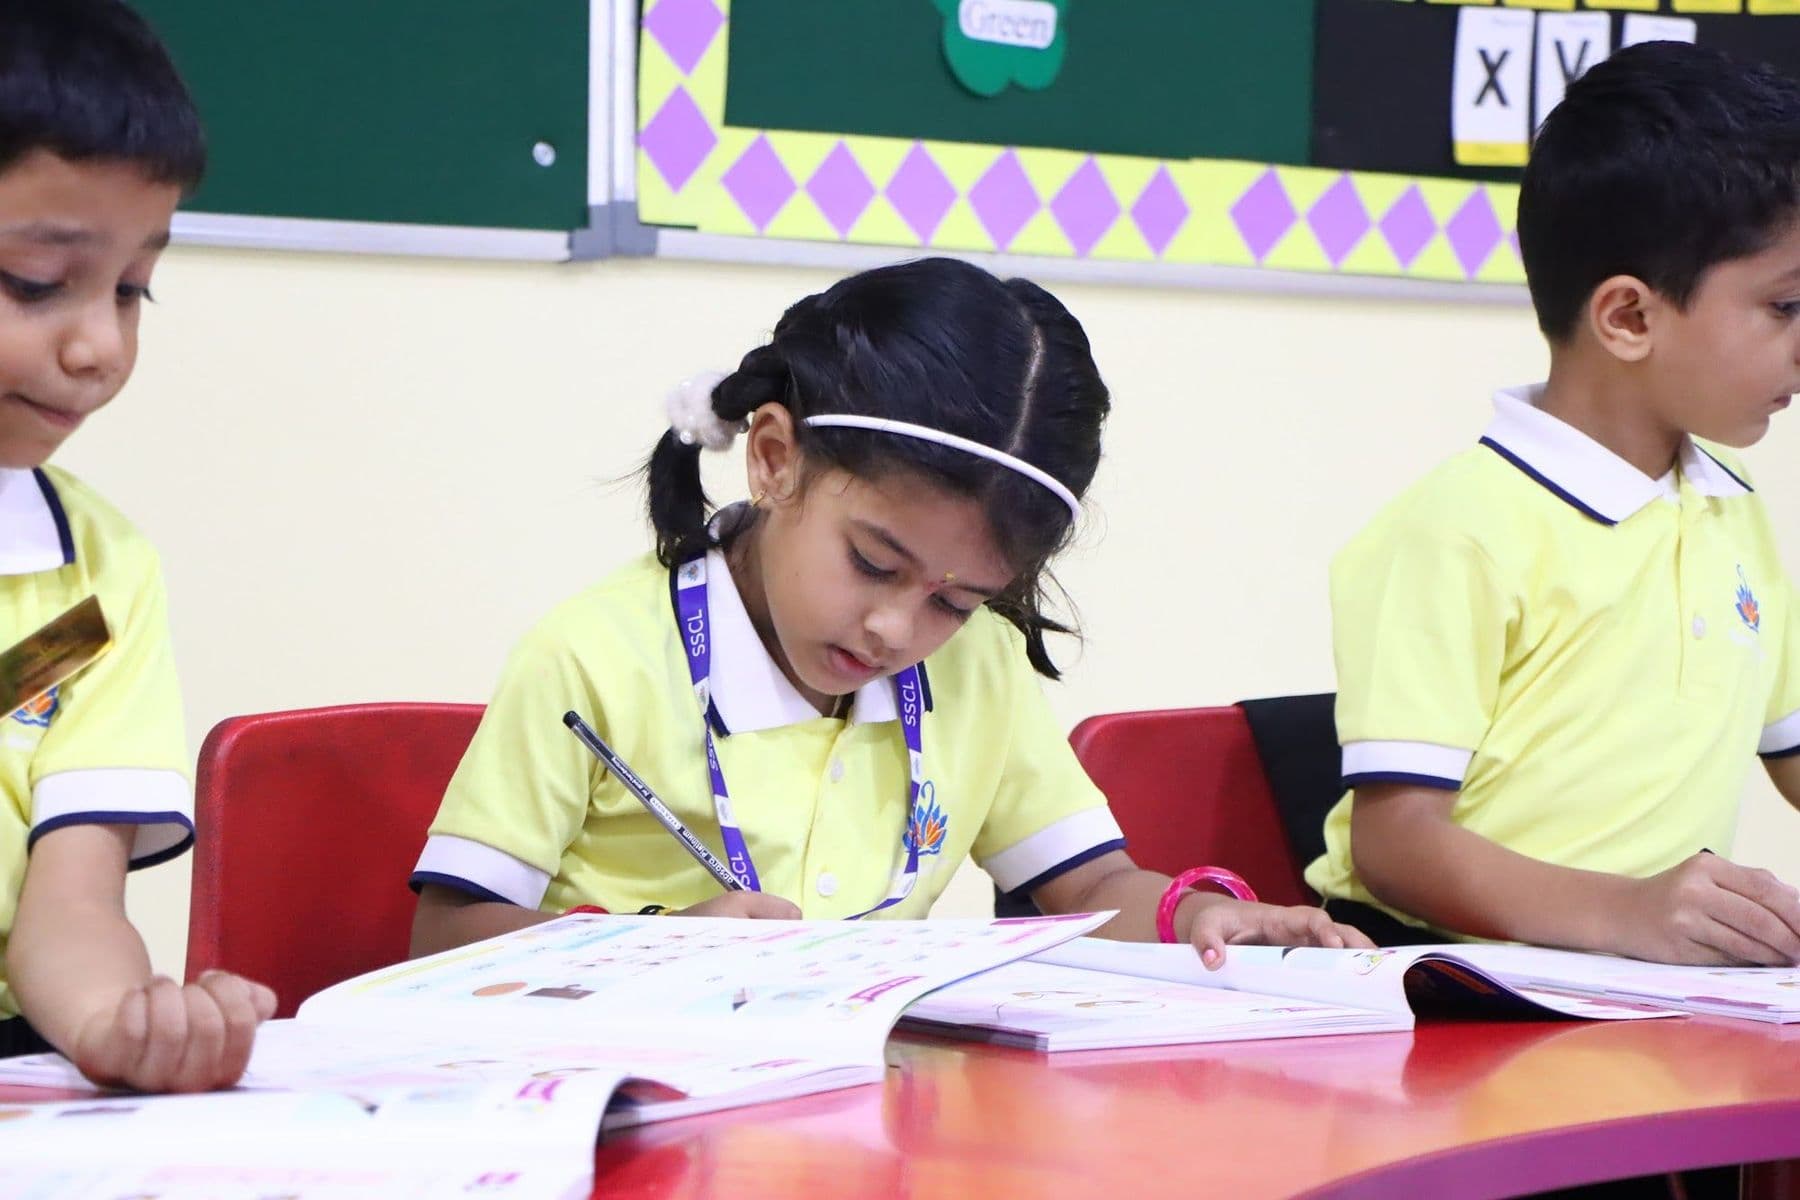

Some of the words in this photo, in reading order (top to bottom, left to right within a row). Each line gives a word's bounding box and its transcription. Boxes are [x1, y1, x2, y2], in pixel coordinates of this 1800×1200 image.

[963, 0, 1051, 42] Green
[1474, 48, 1511, 107] X
[687, 608, 706, 657] SSCL
[902, 680, 916, 727] SSCL
[681, 829, 708, 857] Platinum
[707, 856, 734, 884] apsara
